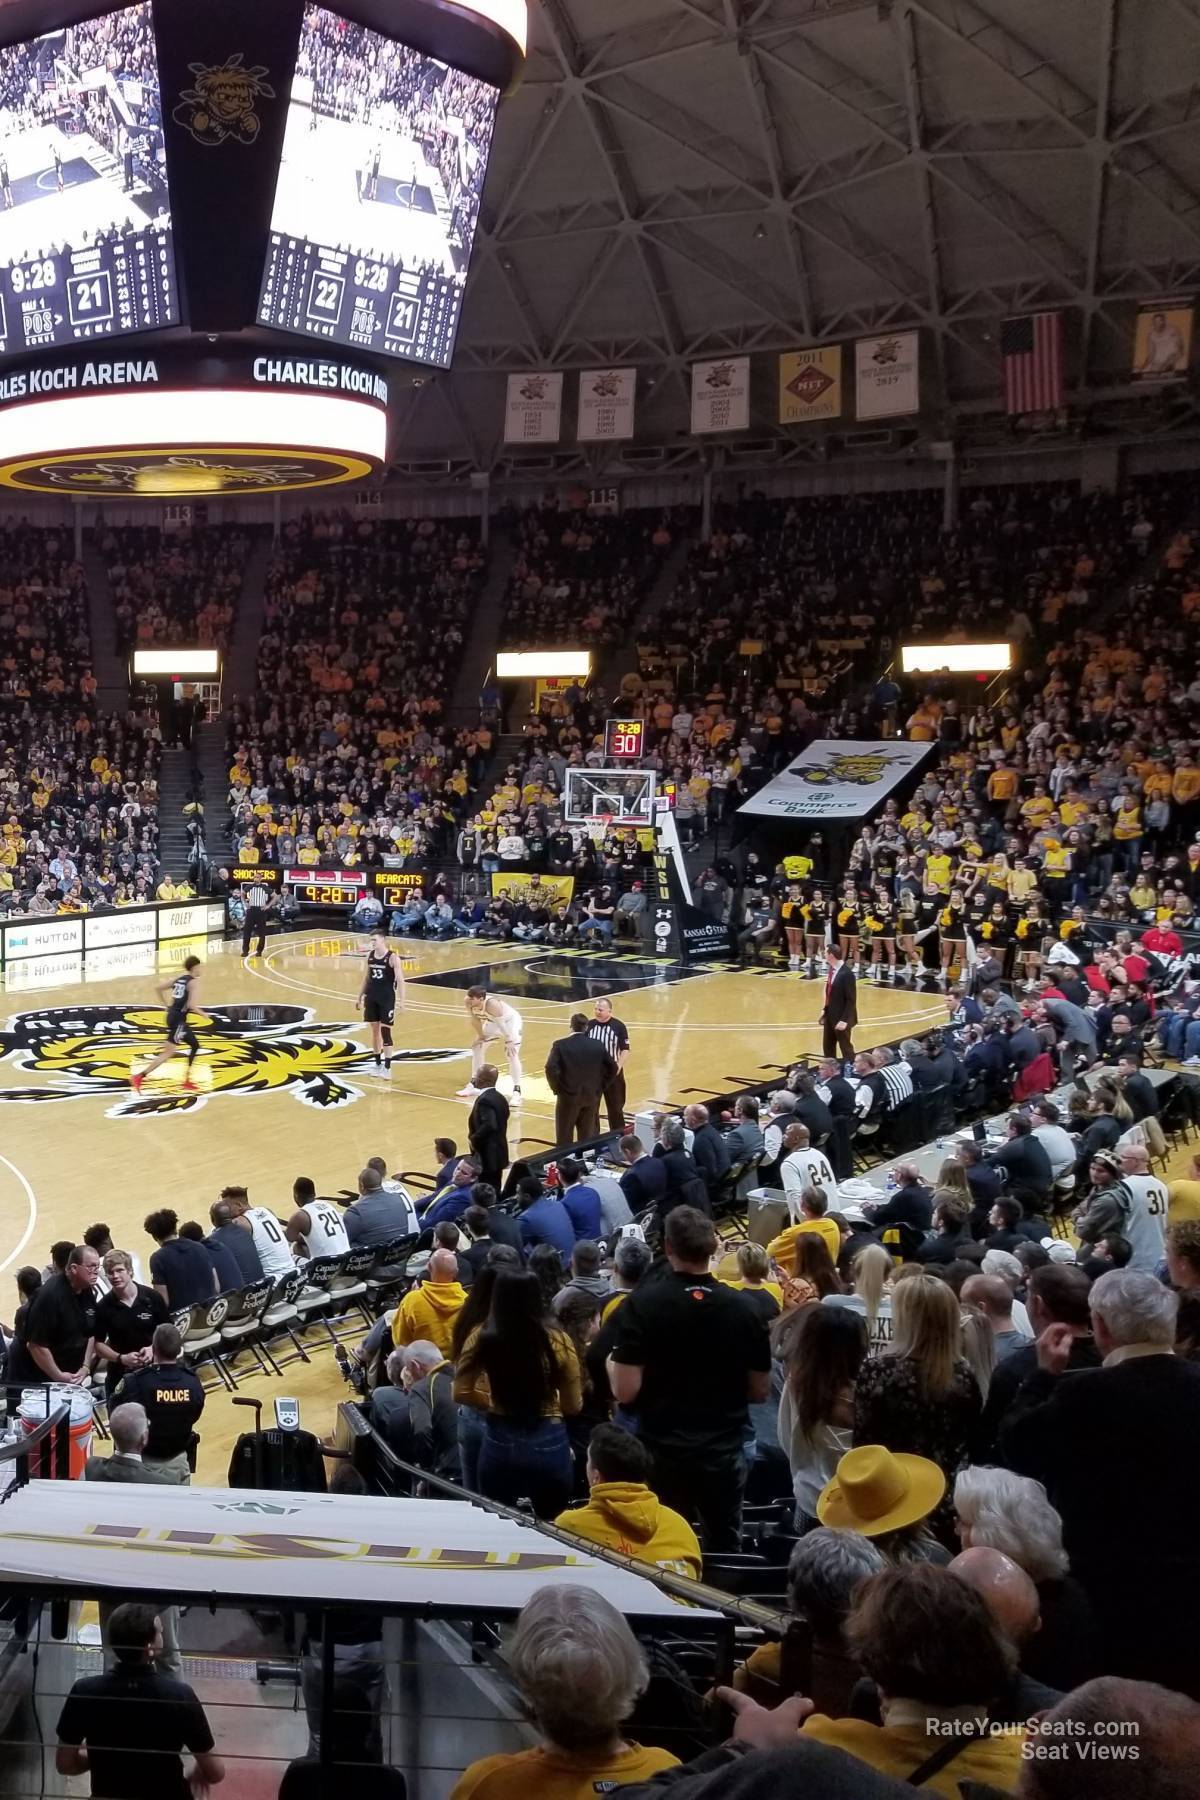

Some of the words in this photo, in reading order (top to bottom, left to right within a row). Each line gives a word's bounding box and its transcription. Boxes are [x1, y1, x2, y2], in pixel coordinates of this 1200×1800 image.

[11, 259, 56, 293] 9:28
[354, 259, 389, 292] 9:28
[77, 279, 102, 310] 21
[315, 279, 339, 310] 22
[351, 310, 375, 334] POS
[393, 301, 414, 329] 21
[23, 311, 53, 336] POS
[797, 350, 824, 365] 2011
[29, 366, 77, 393] KOCH
[81, 360, 159, 387] ARENA
[253, 357, 338, 388] CHARLES
[340, 365, 373, 395] KOCH
[356, 491, 381, 504] 114
[589, 489, 618, 504] 115
[165, 506, 191, 519] 113
[617, 723, 641, 736] 9:28
[614, 735, 636, 753] 30
[768, 798, 858, 808] Commerce
[783, 806, 825, 815] Bank
[375, 873, 422, 885] BEARCATS
[653, 855, 670, 900] WSU
[306, 886, 342, 903] 9:28
[169, 911, 193, 926] FOLEY
[35, 931, 78, 944] HUTTON
[371, 969, 383, 980] 33
[807, 1160, 832, 1185] 24
[1146, 1189, 1165, 1215] 31
[261, 1219, 282, 1243] 0
[317, 1210, 345, 1238] 24
[349, 1252, 376, 1264] Capitol
[315, 1262, 342, 1273] Capitol
[245, 1286, 271, 1301] Capitol
[242, 1295, 268, 1310] Federal
[156, 1388, 190, 1402] POLICE
